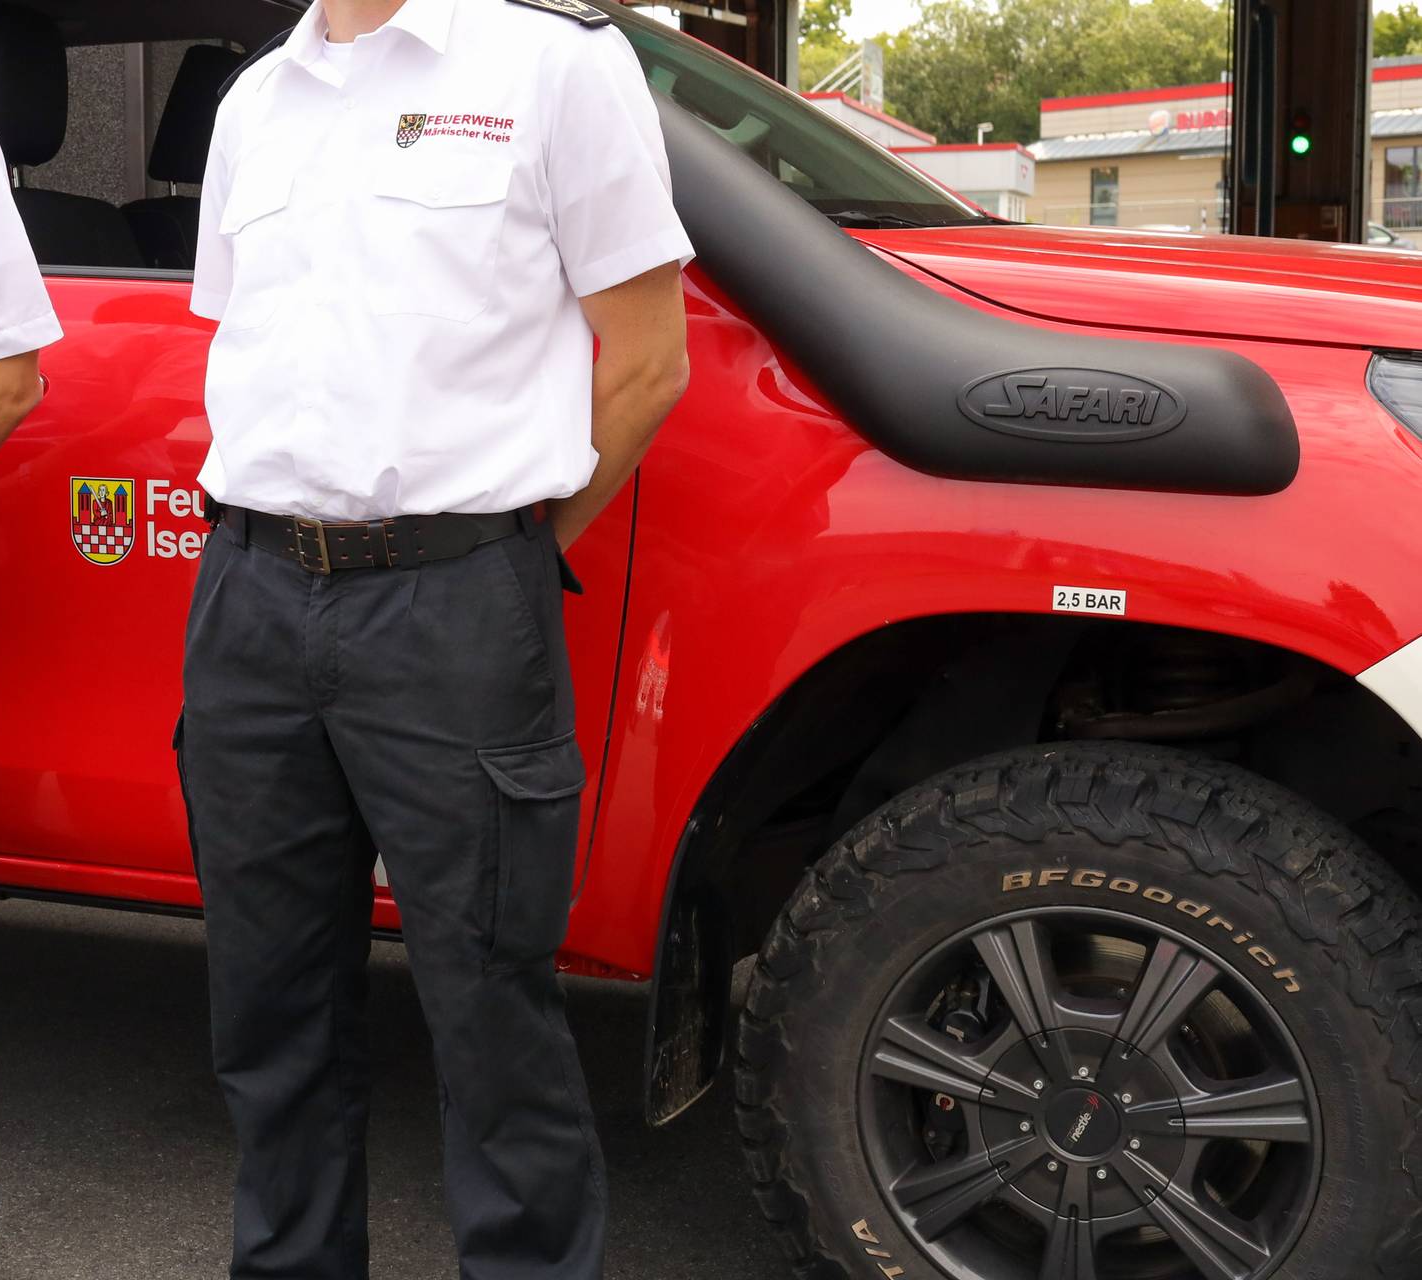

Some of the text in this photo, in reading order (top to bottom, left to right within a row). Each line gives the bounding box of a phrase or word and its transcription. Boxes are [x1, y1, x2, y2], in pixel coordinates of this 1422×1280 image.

[426, 114, 515, 130] FEUERWEHR
[423, 127, 511, 142] Märkischer Kreis
[984, 375, 1160, 425] SAFARI
[1057, 591, 1121, 610] 2,5 BAR
[1001, 867, 1301, 993] BFGoodrich
